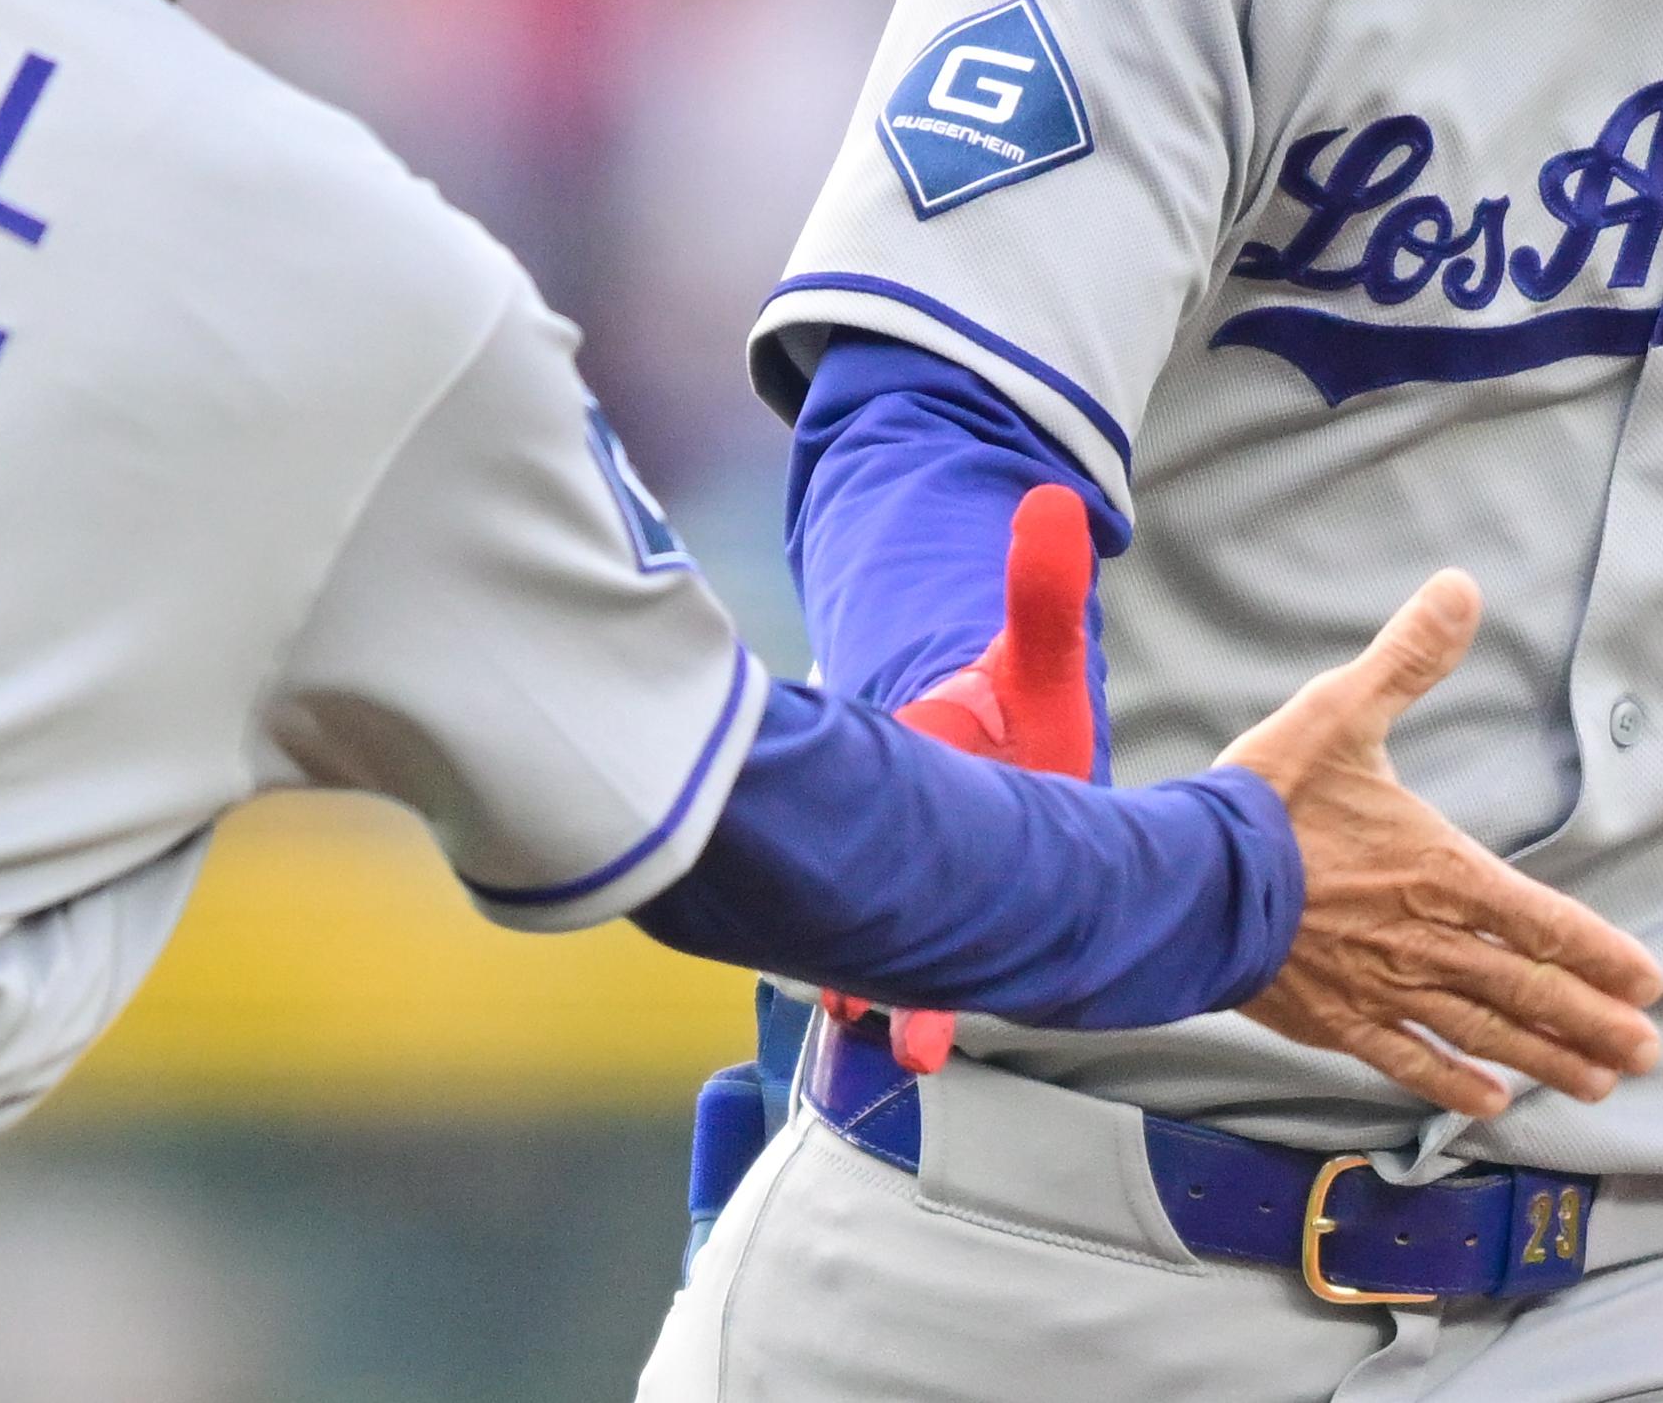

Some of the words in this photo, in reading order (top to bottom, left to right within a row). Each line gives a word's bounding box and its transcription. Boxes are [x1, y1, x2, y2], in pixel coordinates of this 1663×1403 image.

[928, 45, 1035, 124] G
[892, 115, 1026, 164] GUGGENHEIM
[1229, 114, 1511, 309] Los
[1521, 1185, 1580, 1264] 23
